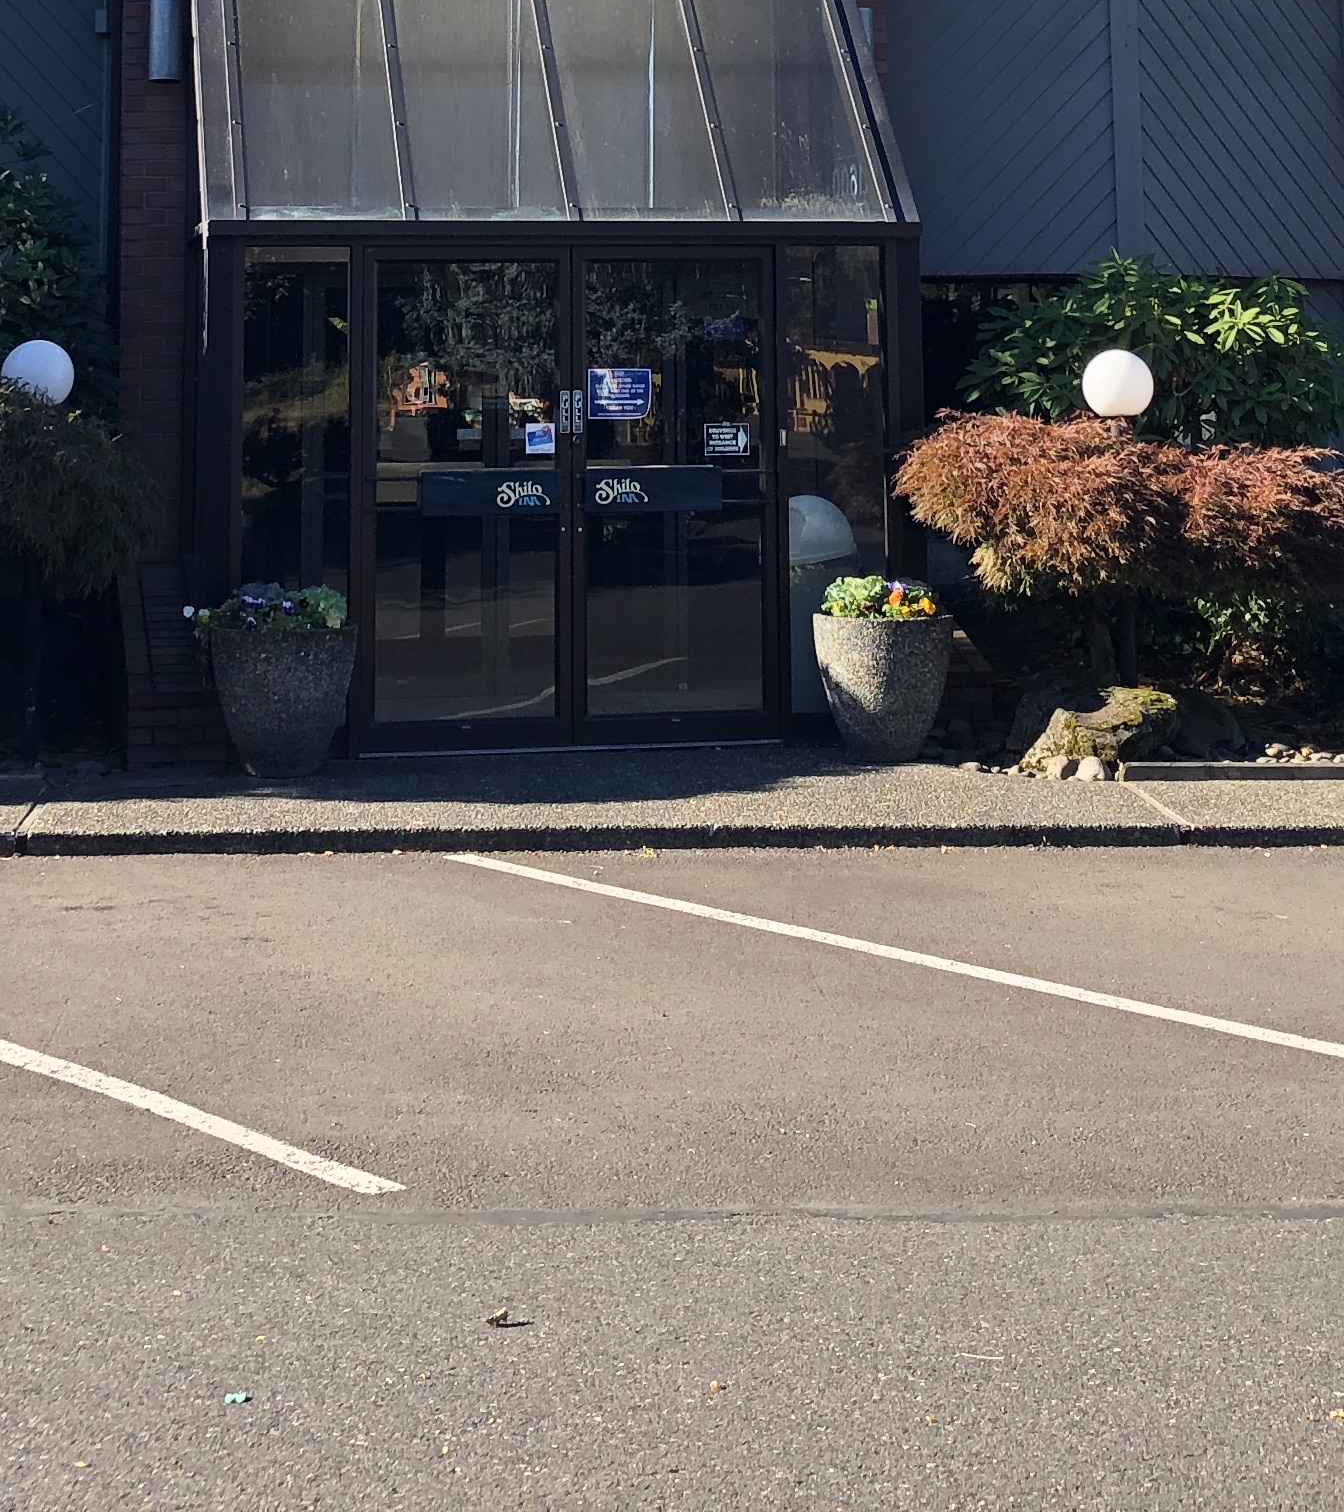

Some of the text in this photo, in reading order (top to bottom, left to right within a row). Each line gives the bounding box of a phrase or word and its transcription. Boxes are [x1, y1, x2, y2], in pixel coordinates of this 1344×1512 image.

[574, 394, 582, 423] PULL
[497, 481, 551, 507] Shilo
[595, 478, 648, 504] Shilo
